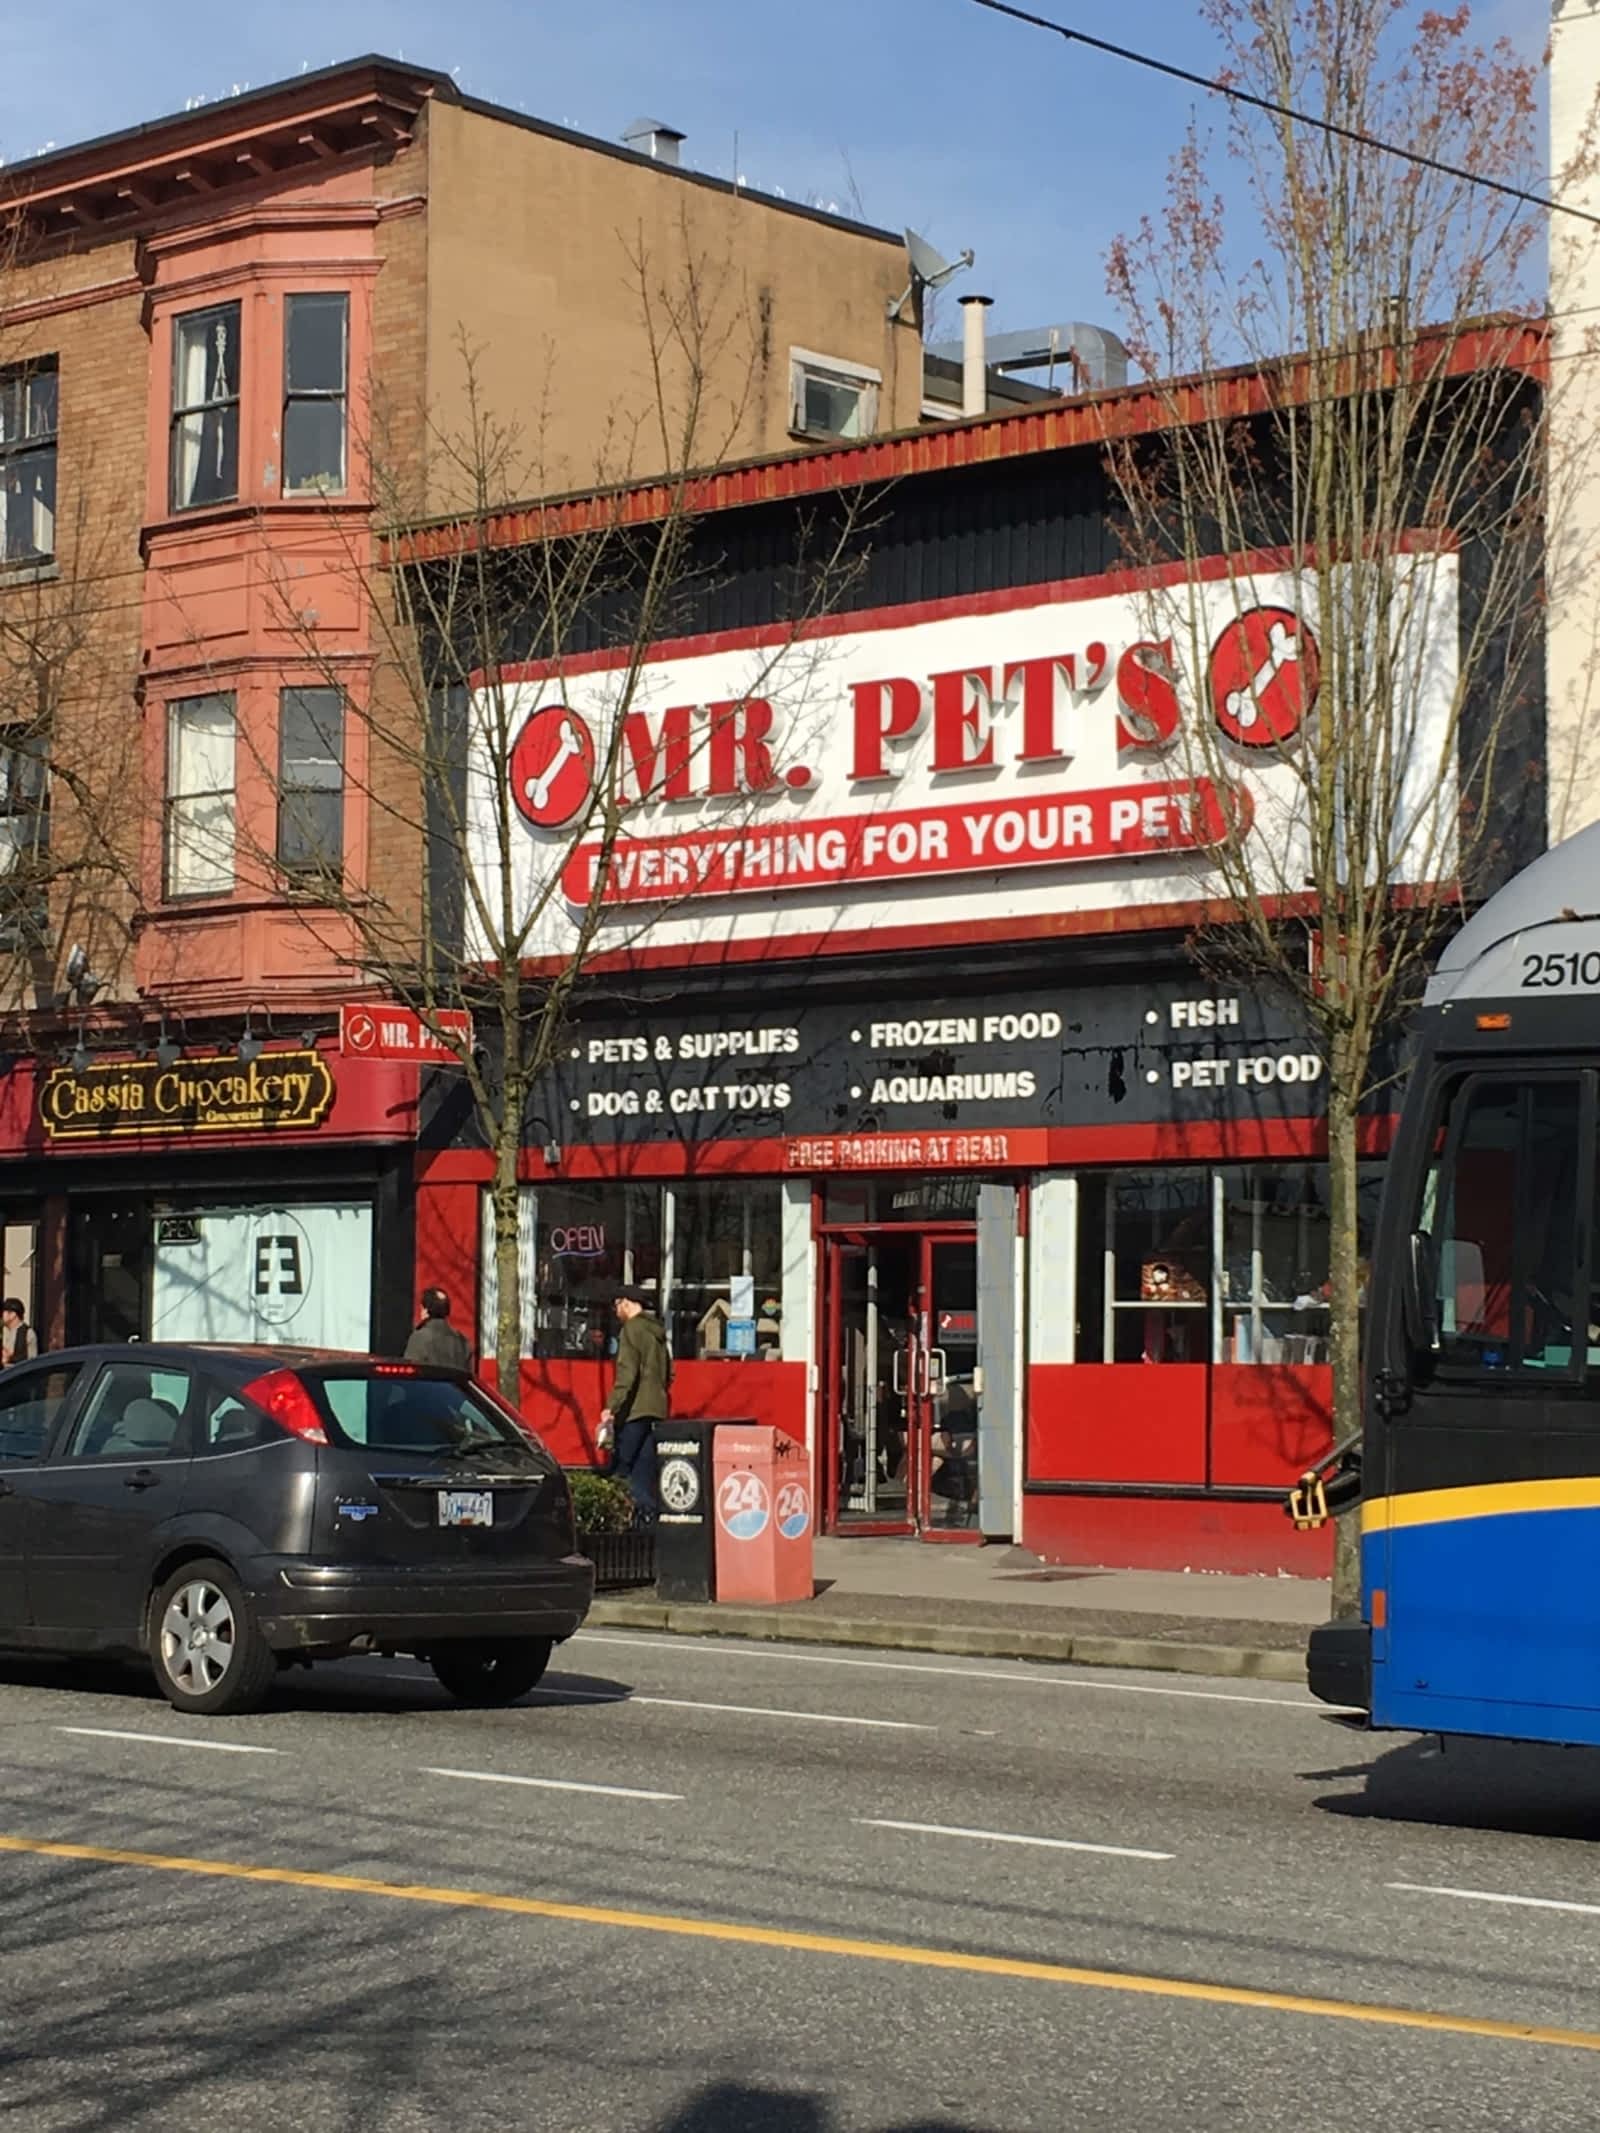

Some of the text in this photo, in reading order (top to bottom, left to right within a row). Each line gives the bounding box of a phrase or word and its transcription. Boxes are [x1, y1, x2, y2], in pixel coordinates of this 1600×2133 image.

[616, 637, 1181, 806] MR. PET'S
[588, 792, 1201, 893] EVERYTHING FOR YOUR PET
[870, 1012, 1062, 1048] FROZEN FOOD
[1171, 999, 1239, 1028] FISH
[380, 1022, 415, 1048] MR.
[587, 1028, 800, 1063] PETS & SUPPLIES
[870, 1071, 1036, 1103] AQUARIUMS
[1172, 1055, 1322, 1088] PET FOOD
[52, 1062, 313, 1119] Cassia Cupcakery
[587, 1083, 792, 1116] DOG & CAT TOYS
[788, 1135, 1008, 1167] FREE PARKING AT REAR
[550, 1225, 605, 1252] OPEN
[723, 1477, 762, 1511] 24
[779, 1487, 804, 1517] 24
